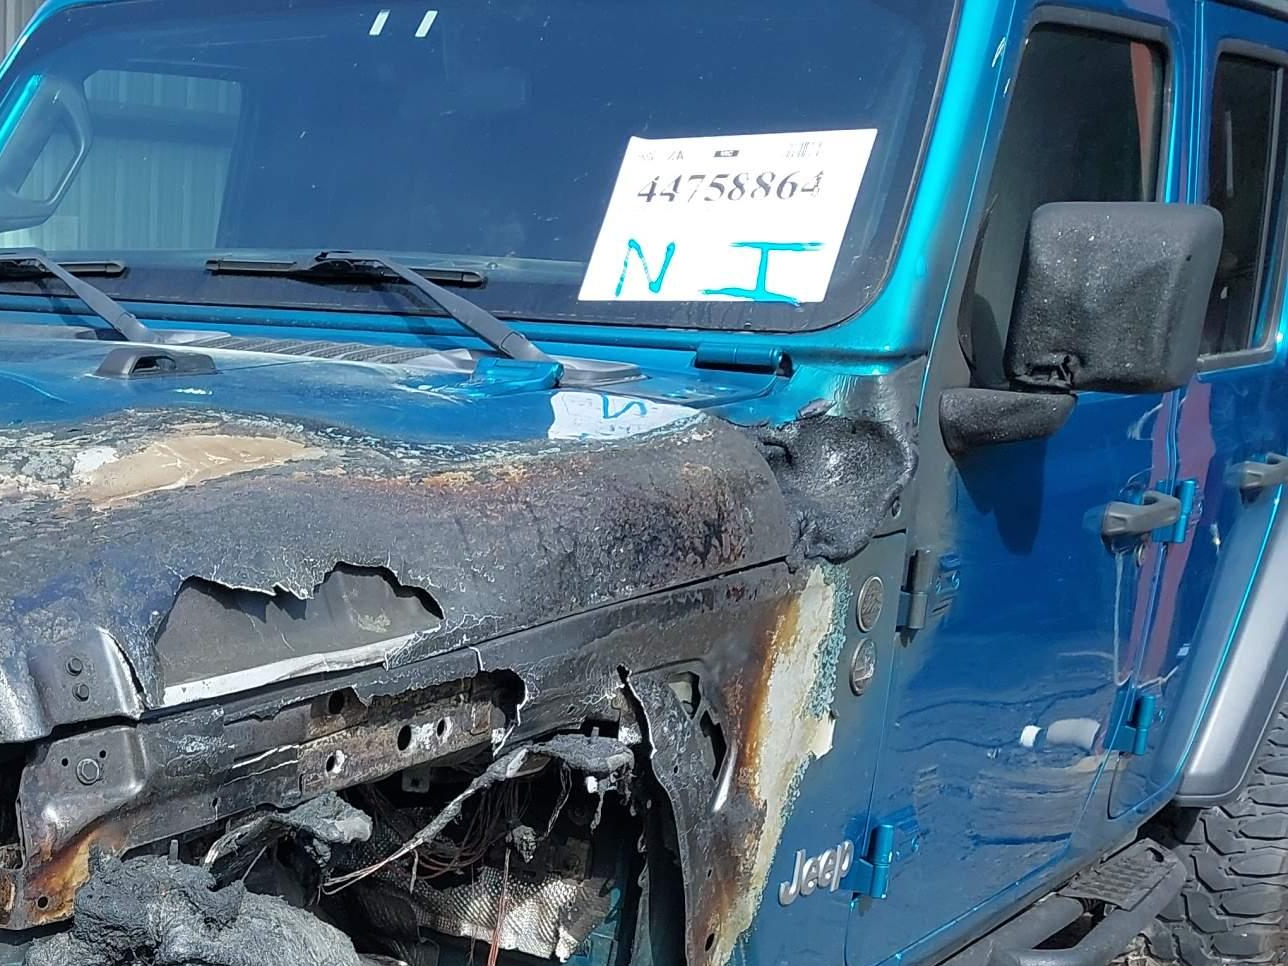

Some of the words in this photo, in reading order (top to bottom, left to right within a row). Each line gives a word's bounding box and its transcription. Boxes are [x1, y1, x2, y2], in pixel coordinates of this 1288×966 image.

[637, 171, 824, 202] 44758864
[615, 238, 675, 297] N
[779, 840, 854, 905] Jeep
